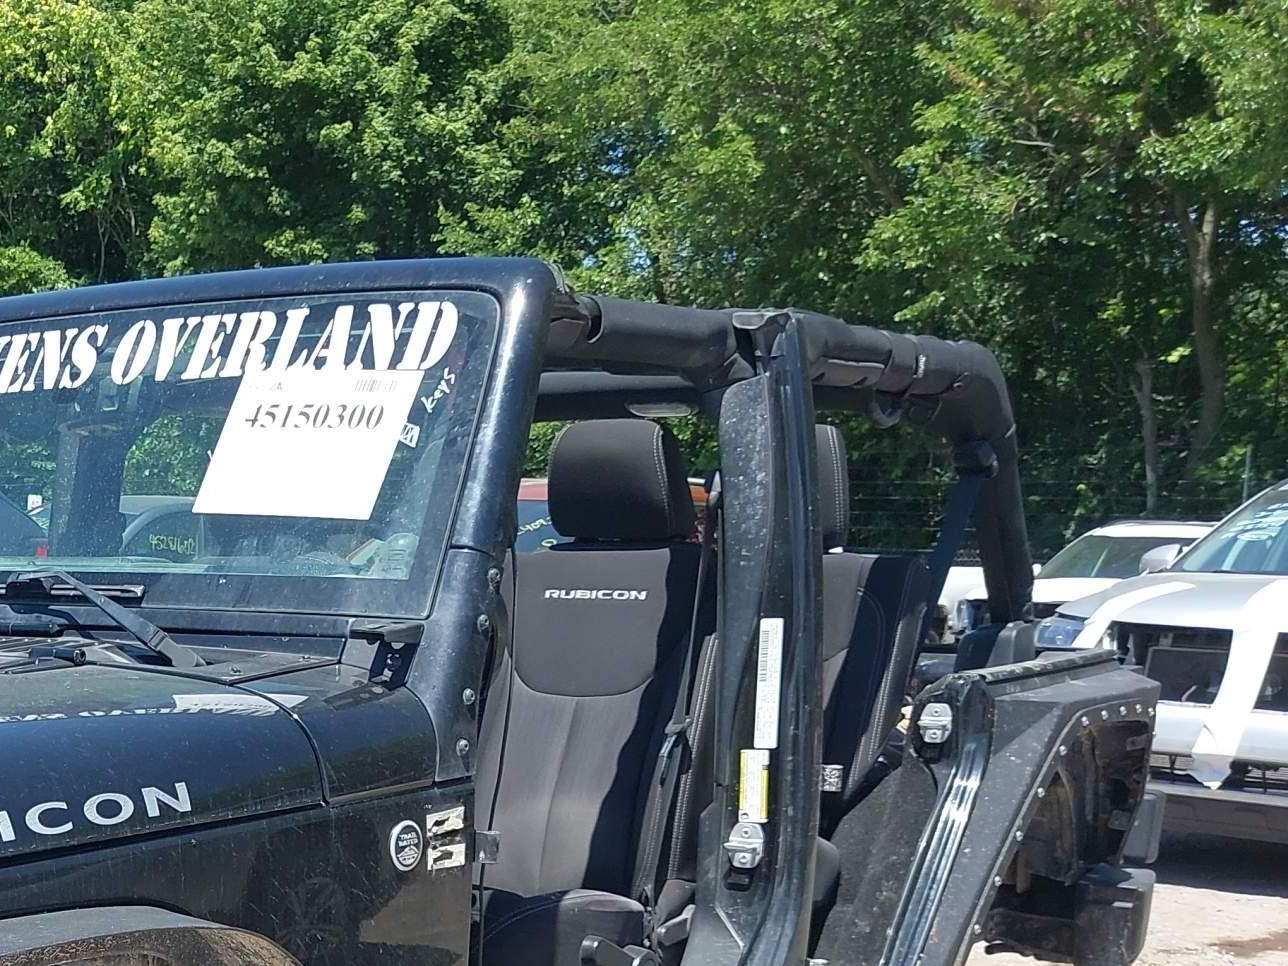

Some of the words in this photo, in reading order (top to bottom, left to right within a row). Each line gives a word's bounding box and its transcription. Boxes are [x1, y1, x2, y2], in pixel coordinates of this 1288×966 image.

[110, 301, 460, 386] OVERLAND
[245, 404, 385, 430] 45150300
[544, 589, 648, 600] RUBICON
